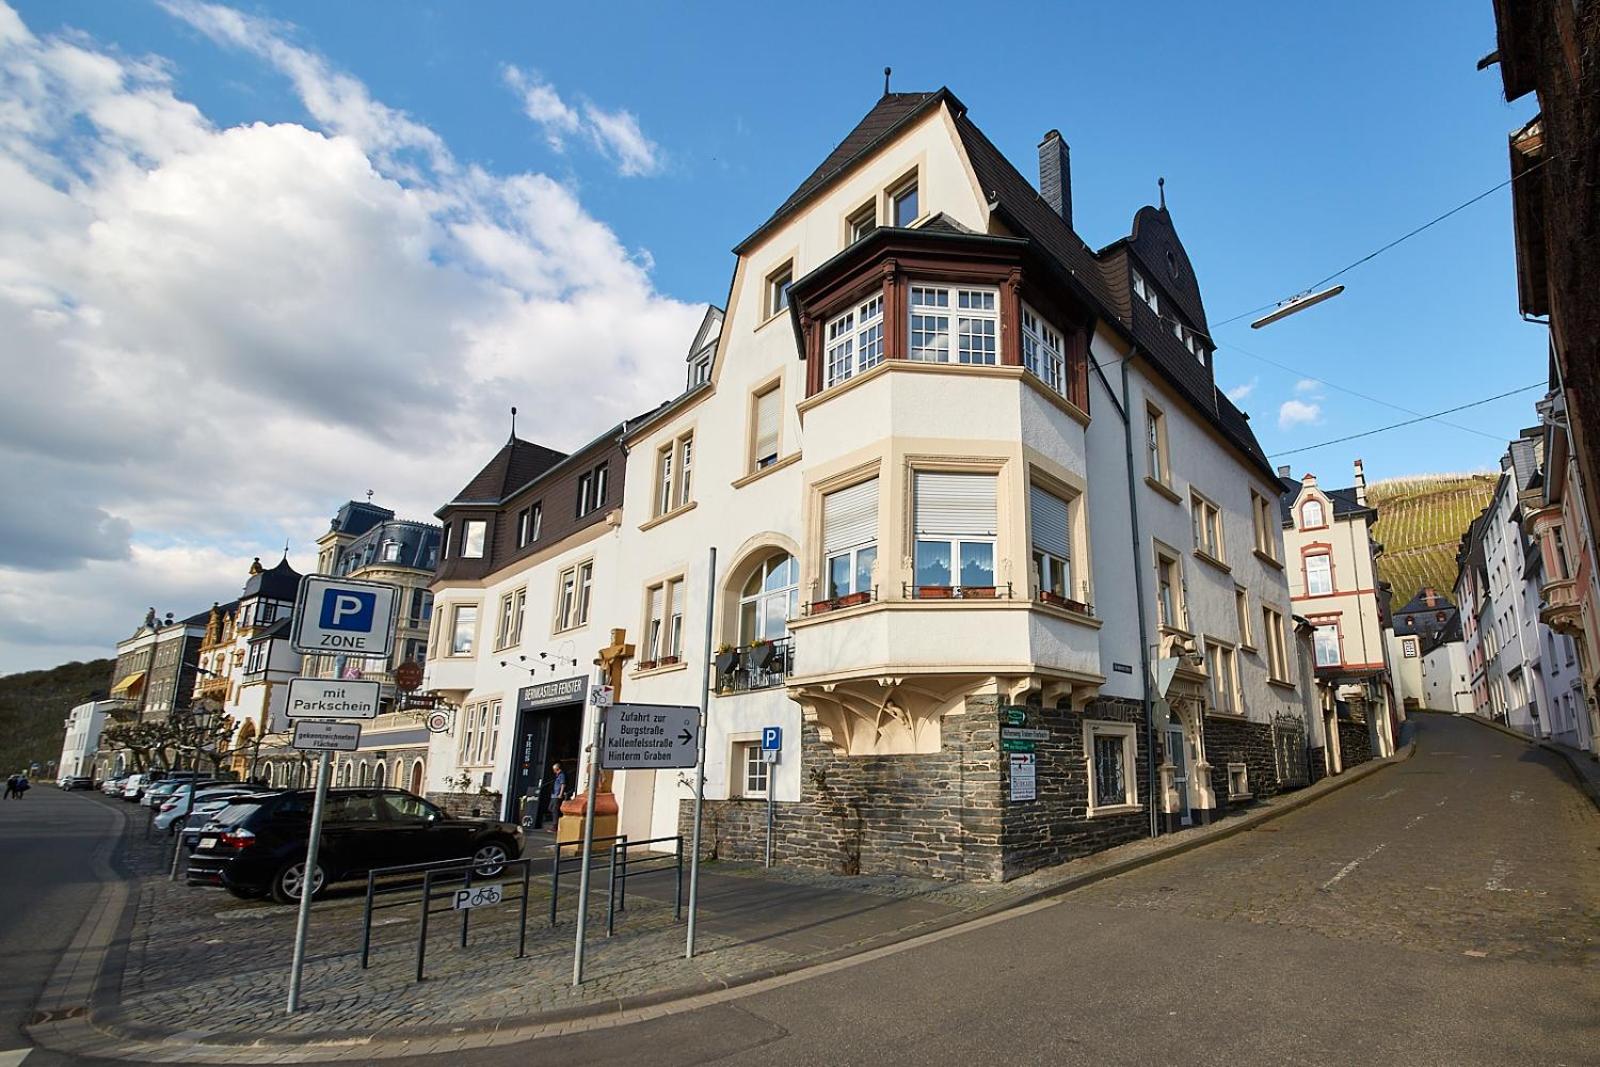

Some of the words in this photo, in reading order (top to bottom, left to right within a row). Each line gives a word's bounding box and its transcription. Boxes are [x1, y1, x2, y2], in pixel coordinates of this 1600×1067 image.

[333, 595, 362, 625] P
[321, 634, 366, 649] ZONE
[323, 688, 346, 699] mit
[558, 679, 582, 695] FENSTER
[293, 699, 371, 712] Parkschein
[620, 711, 651, 722] Zufahrt
[653, 715, 667, 723] zur
[620, 724, 664, 737] Burgstraße
[608, 737, 673, 748] Kallenfelsstraße
[766, 729, 777, 748] P
[608, 751, 641, 761] Hinterm
[643, 751, 672, 761] Graben
[456, 890, 470, 909] P
